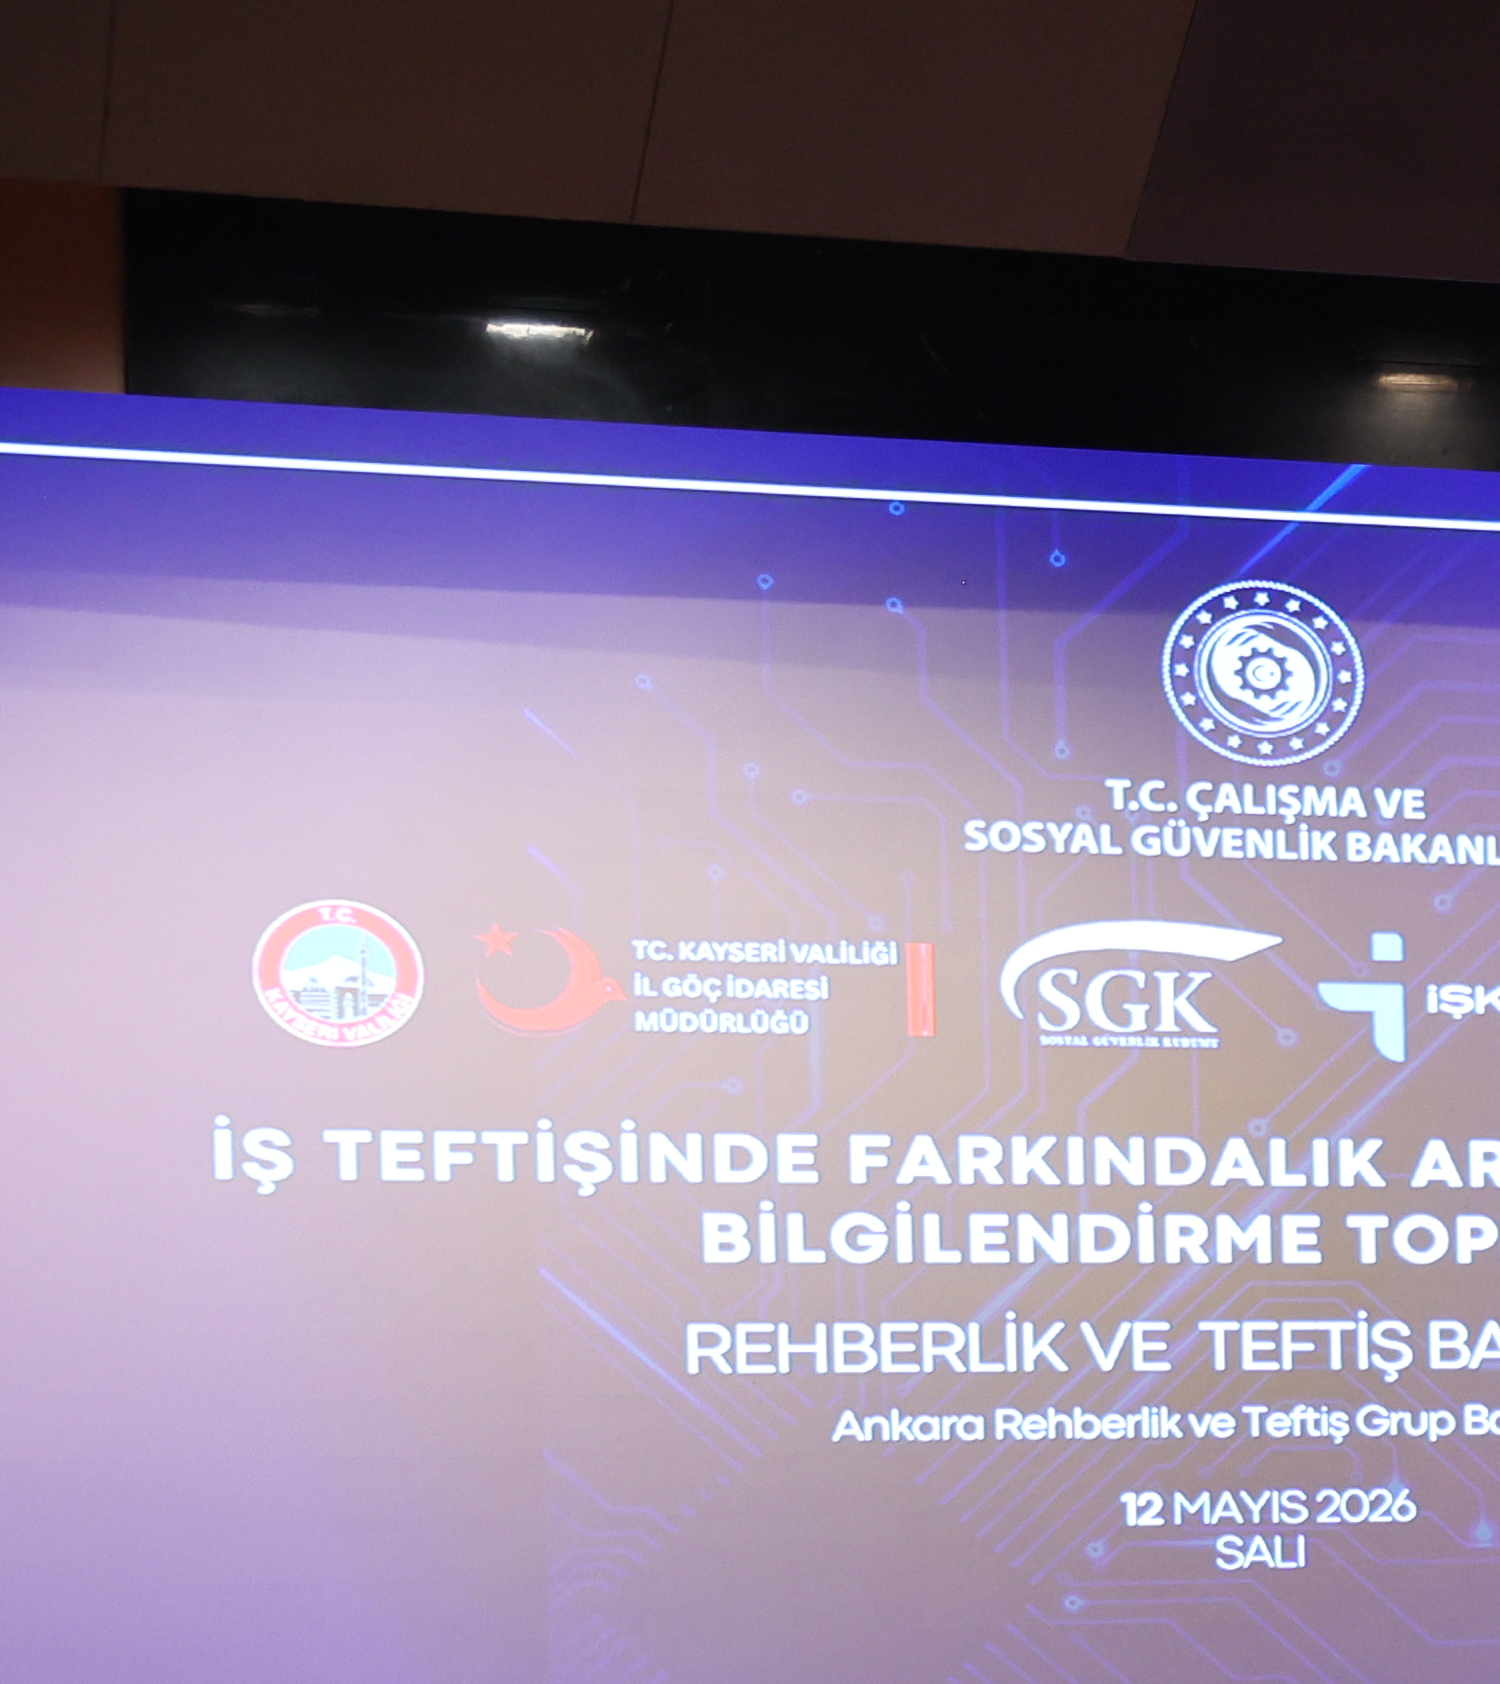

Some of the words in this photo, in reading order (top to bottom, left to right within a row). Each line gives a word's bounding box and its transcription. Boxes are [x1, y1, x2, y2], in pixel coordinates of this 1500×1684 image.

[1105, 779, 1177, 812] T.C.
[1186, 782, 1367, 825] ÇALIŞMA
[1374, 788, 1426, 819] VE
[964, 820, 1123, 855] SOSYAL
[1132, 820, 1337, 861] GÜVENLİK
[678, 938, 786, 963] KAYSERİ
[789, 939, 897, 966] VALİLİĞİ
[634, 971, 659, 997] İL
[661, 973, 722, 1004] GÖÇ
[726, 973, 829, 1001] İDARESİ
[1038, 968, 1217, 1033] SGK
[635, 1007, 809, 1035] MÜDÜRLÜĞÜ
[213, 1114, 293, 1195] İŞ
[323, 1118, 819, 1197] TEFTİŞİNDE
[849, 1134, 1386, 1187] FARKINDALIK
[702, 1200, 1321, 1264] BİLGİLENDİRME
[687, 1311, 1069, 1375] REHBERLİK
[1080, 1322, 1171, 1371] VE
[1198, 1310, 1413, 1383] TEFTİŞ
[832, 1408, 984, 1442] Ankara
[995, 1406, 1183, 1440] Rehberlik
[1188, 1412, 1236, 1438] ve
[1242, 1404, 1350, 1444] Teftiş
[1356, 1404, 1456, 1442] Grup
[1120, 1492, 1165, 1526] 12
[1174, 1490, 1309, 1525] MAYIS
[1316, 1488, 1417, 1523] 2026
[1216, 1535, 1305, 1570] SALI
